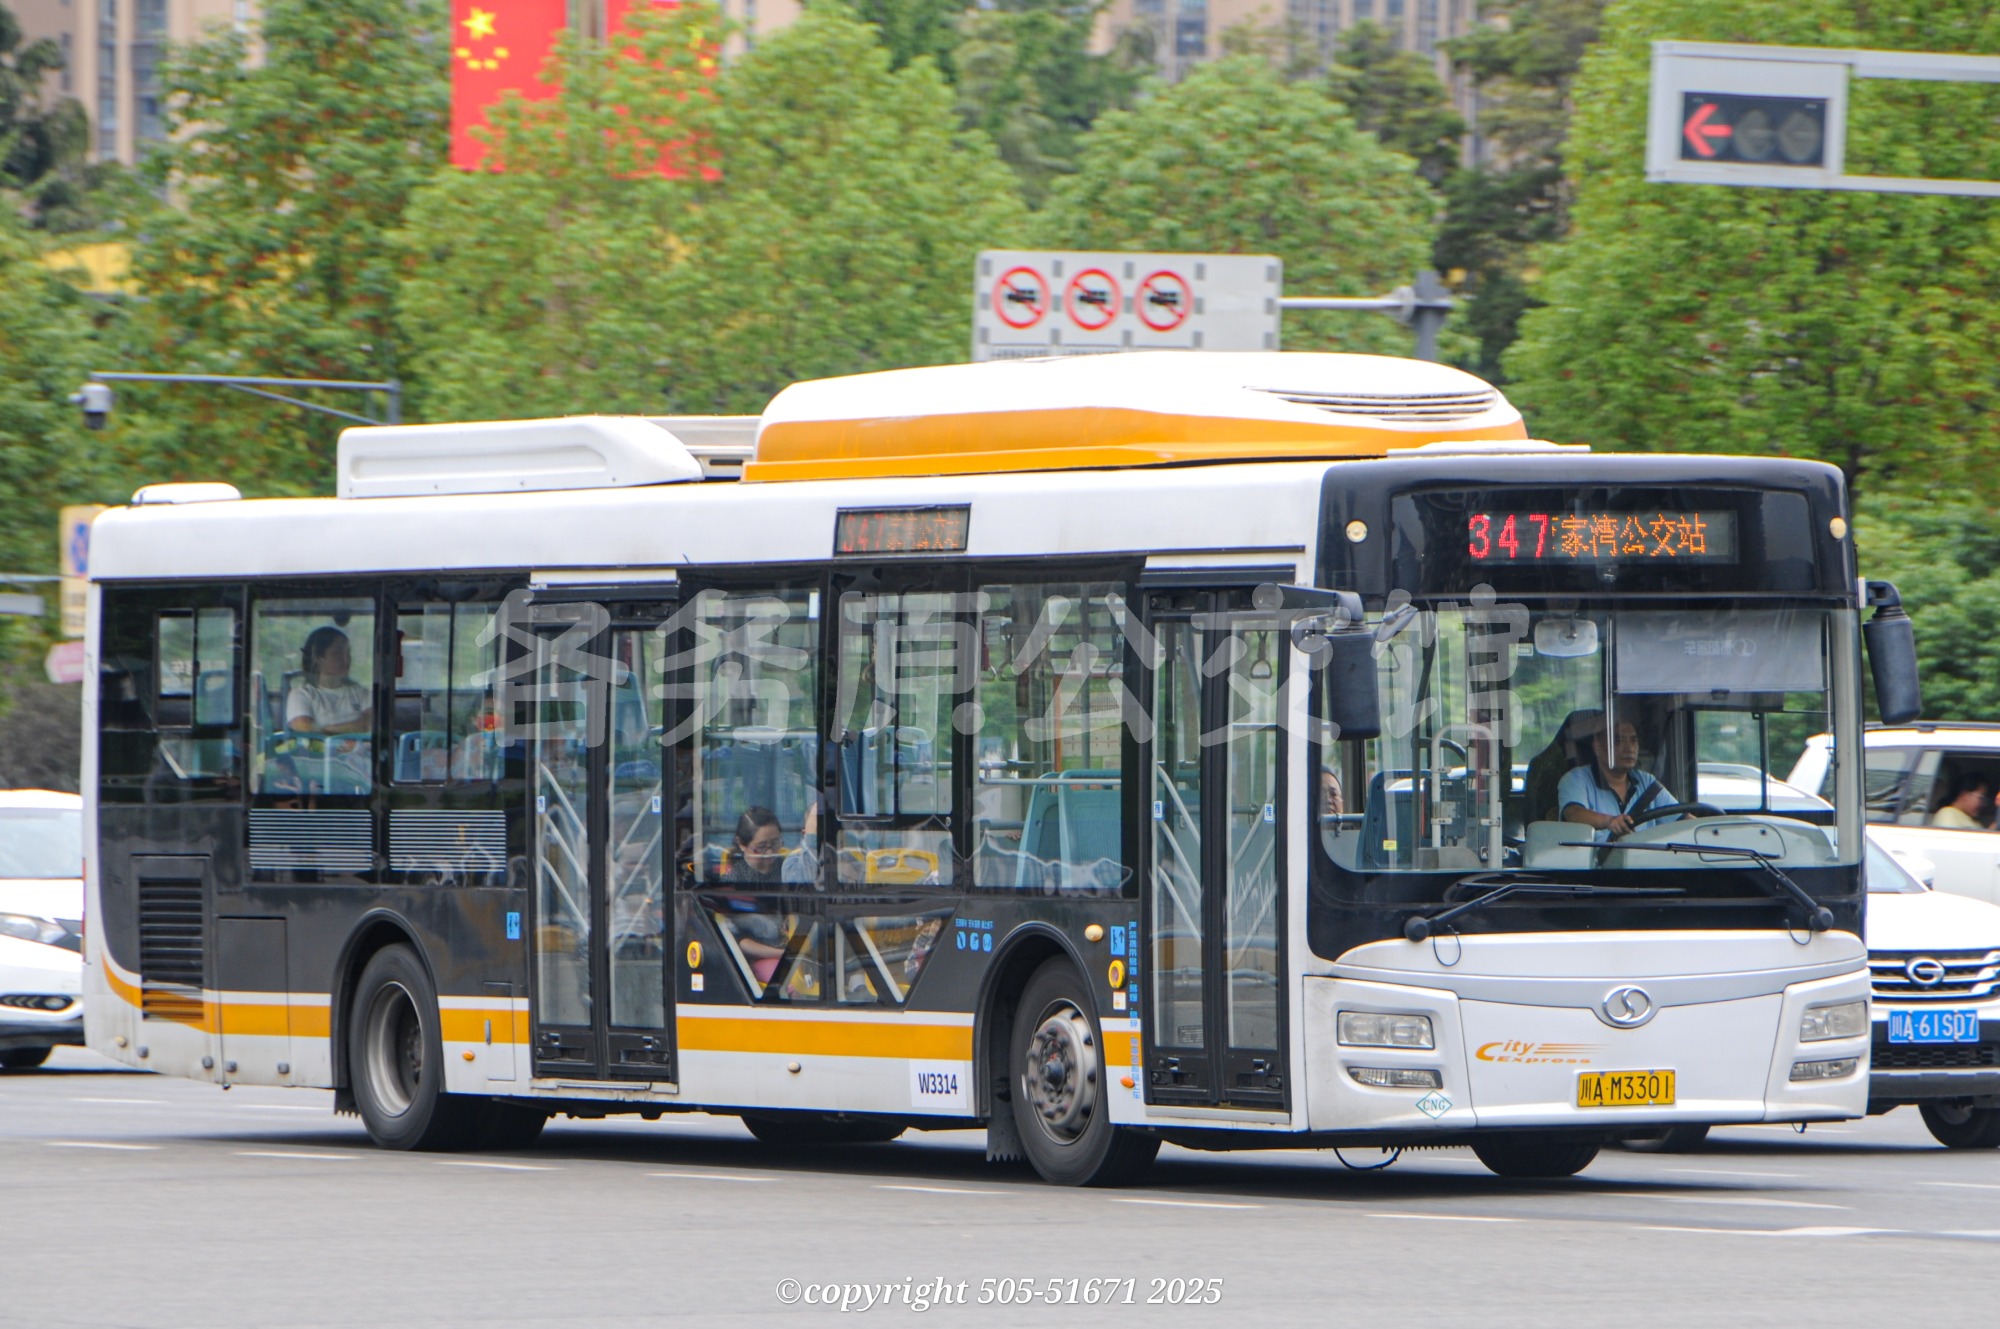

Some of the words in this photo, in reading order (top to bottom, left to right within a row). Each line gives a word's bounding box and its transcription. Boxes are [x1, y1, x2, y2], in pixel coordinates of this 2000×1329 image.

[1468, 513, 1548, 558] 347
[1552, 513, 1707, 557] 家湾公交站
[1475, 1039, 1535, 1061] City
[918, 1072, 958, 1095] W3314
[1422, 1099, 1446, 1111] CNG
